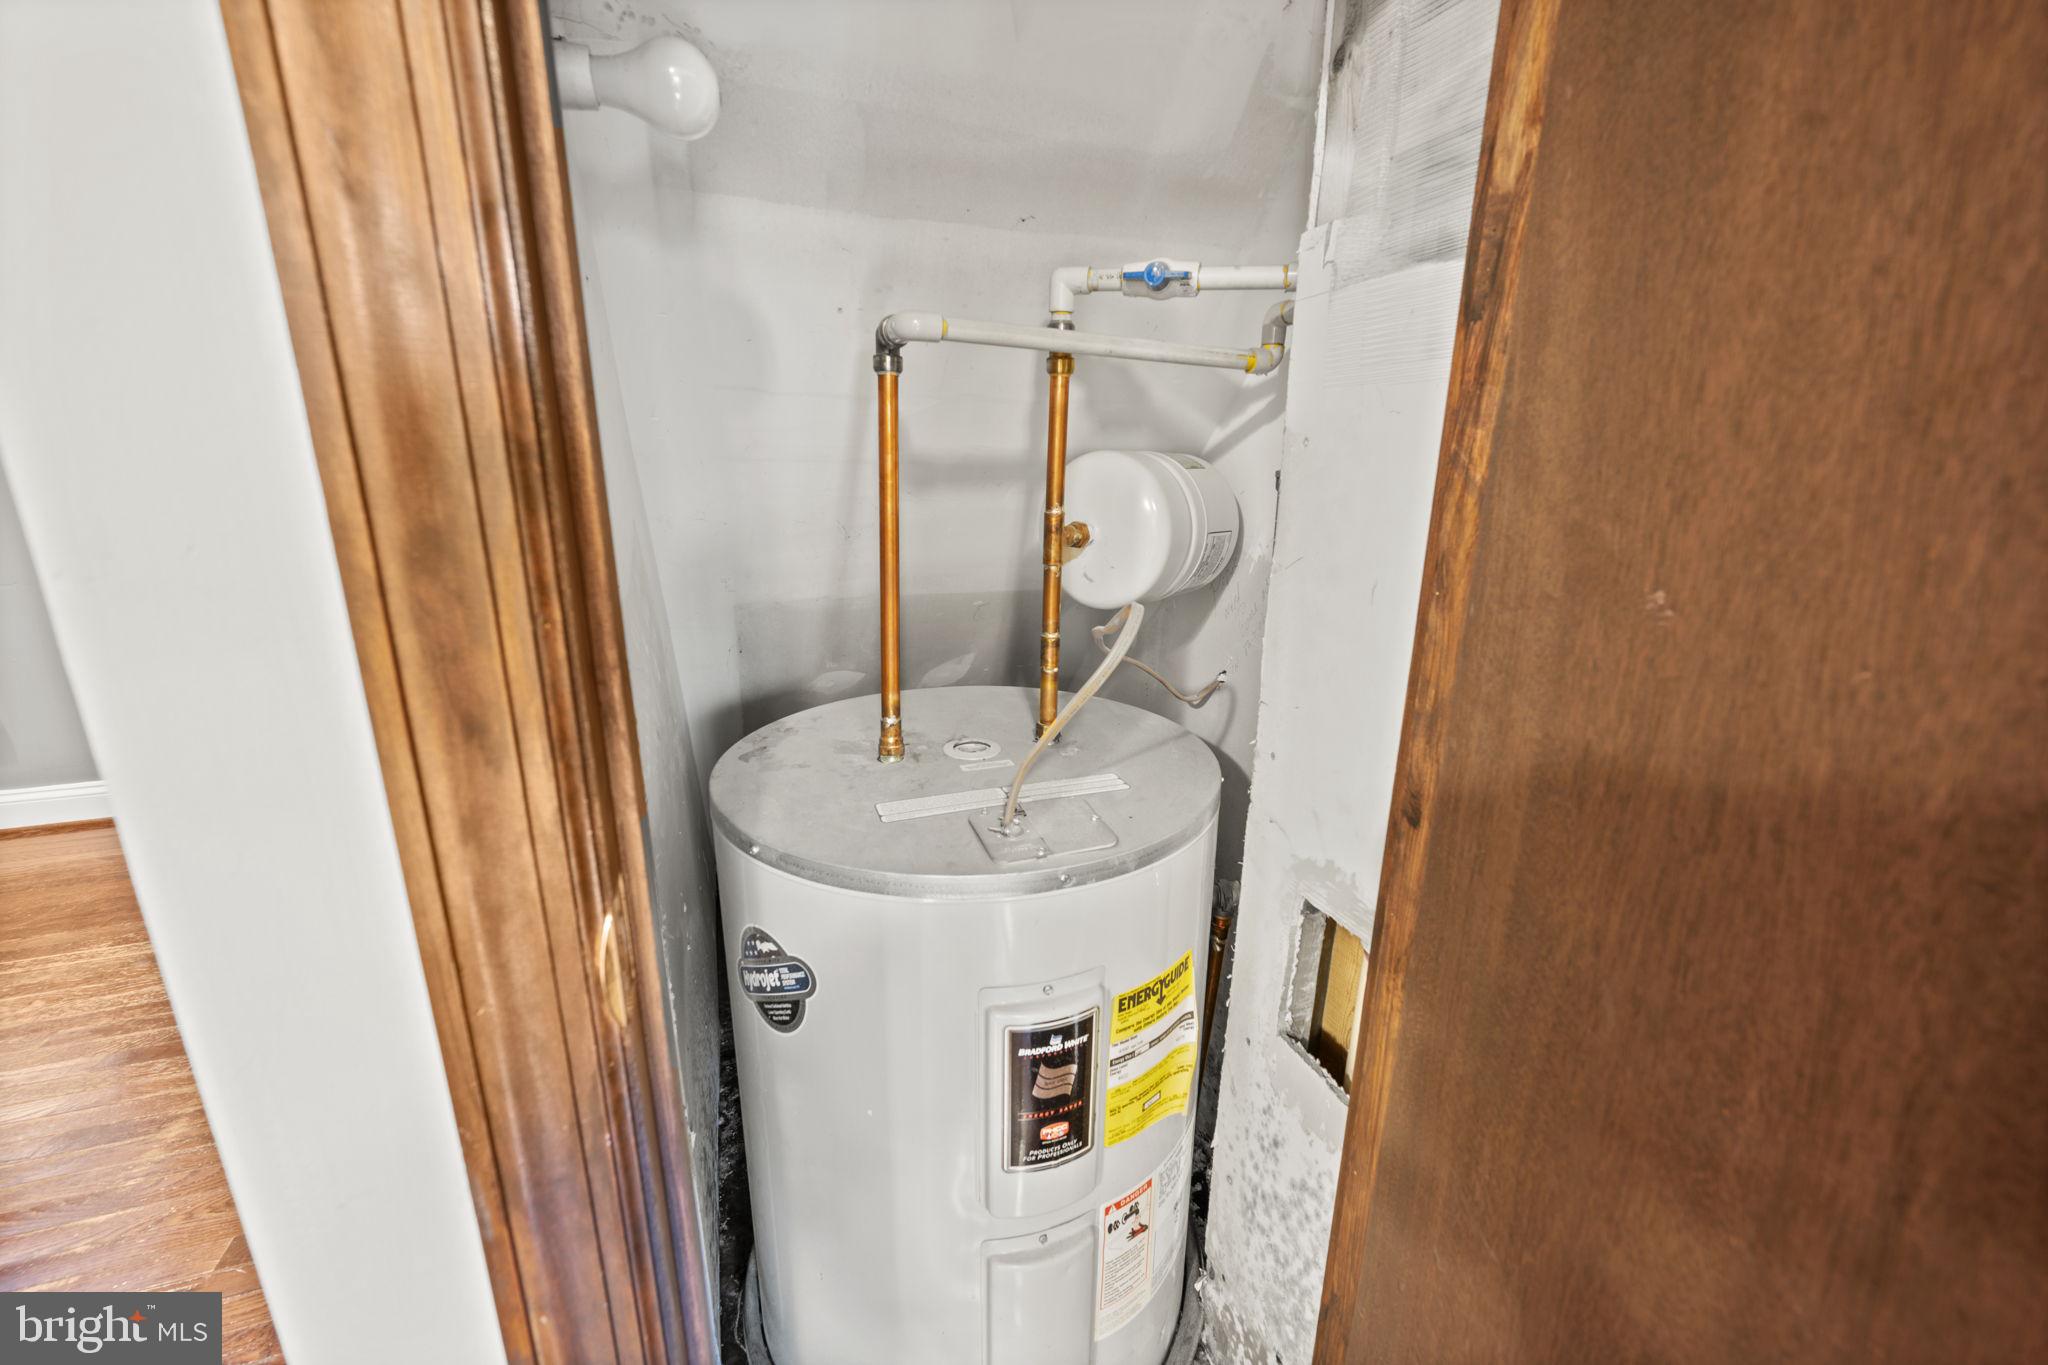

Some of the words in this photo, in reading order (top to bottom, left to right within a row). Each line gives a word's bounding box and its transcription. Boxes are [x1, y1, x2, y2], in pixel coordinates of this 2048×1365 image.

[742, 968, 781, 992] Hydrojet
[1118, 955, 1190, 1014] ENERGYGUIDE
[1018, 1043, 1064, 1056] BRADFORD
[1064, 1033, 1089, 1049] WHITE
[1023, 1110, 1055, 1119] ENERGY
[1059, 1100, 1083, 1113] SAVER
[1029, 1145, 1061, 1156] PRODUCTS
[1061, 1138, 1078, 1149] ONLY
[1037, 1141, 1083, 1160] PROFESSIONALS
[1119, 1182, 1149, 1207] DANGER
